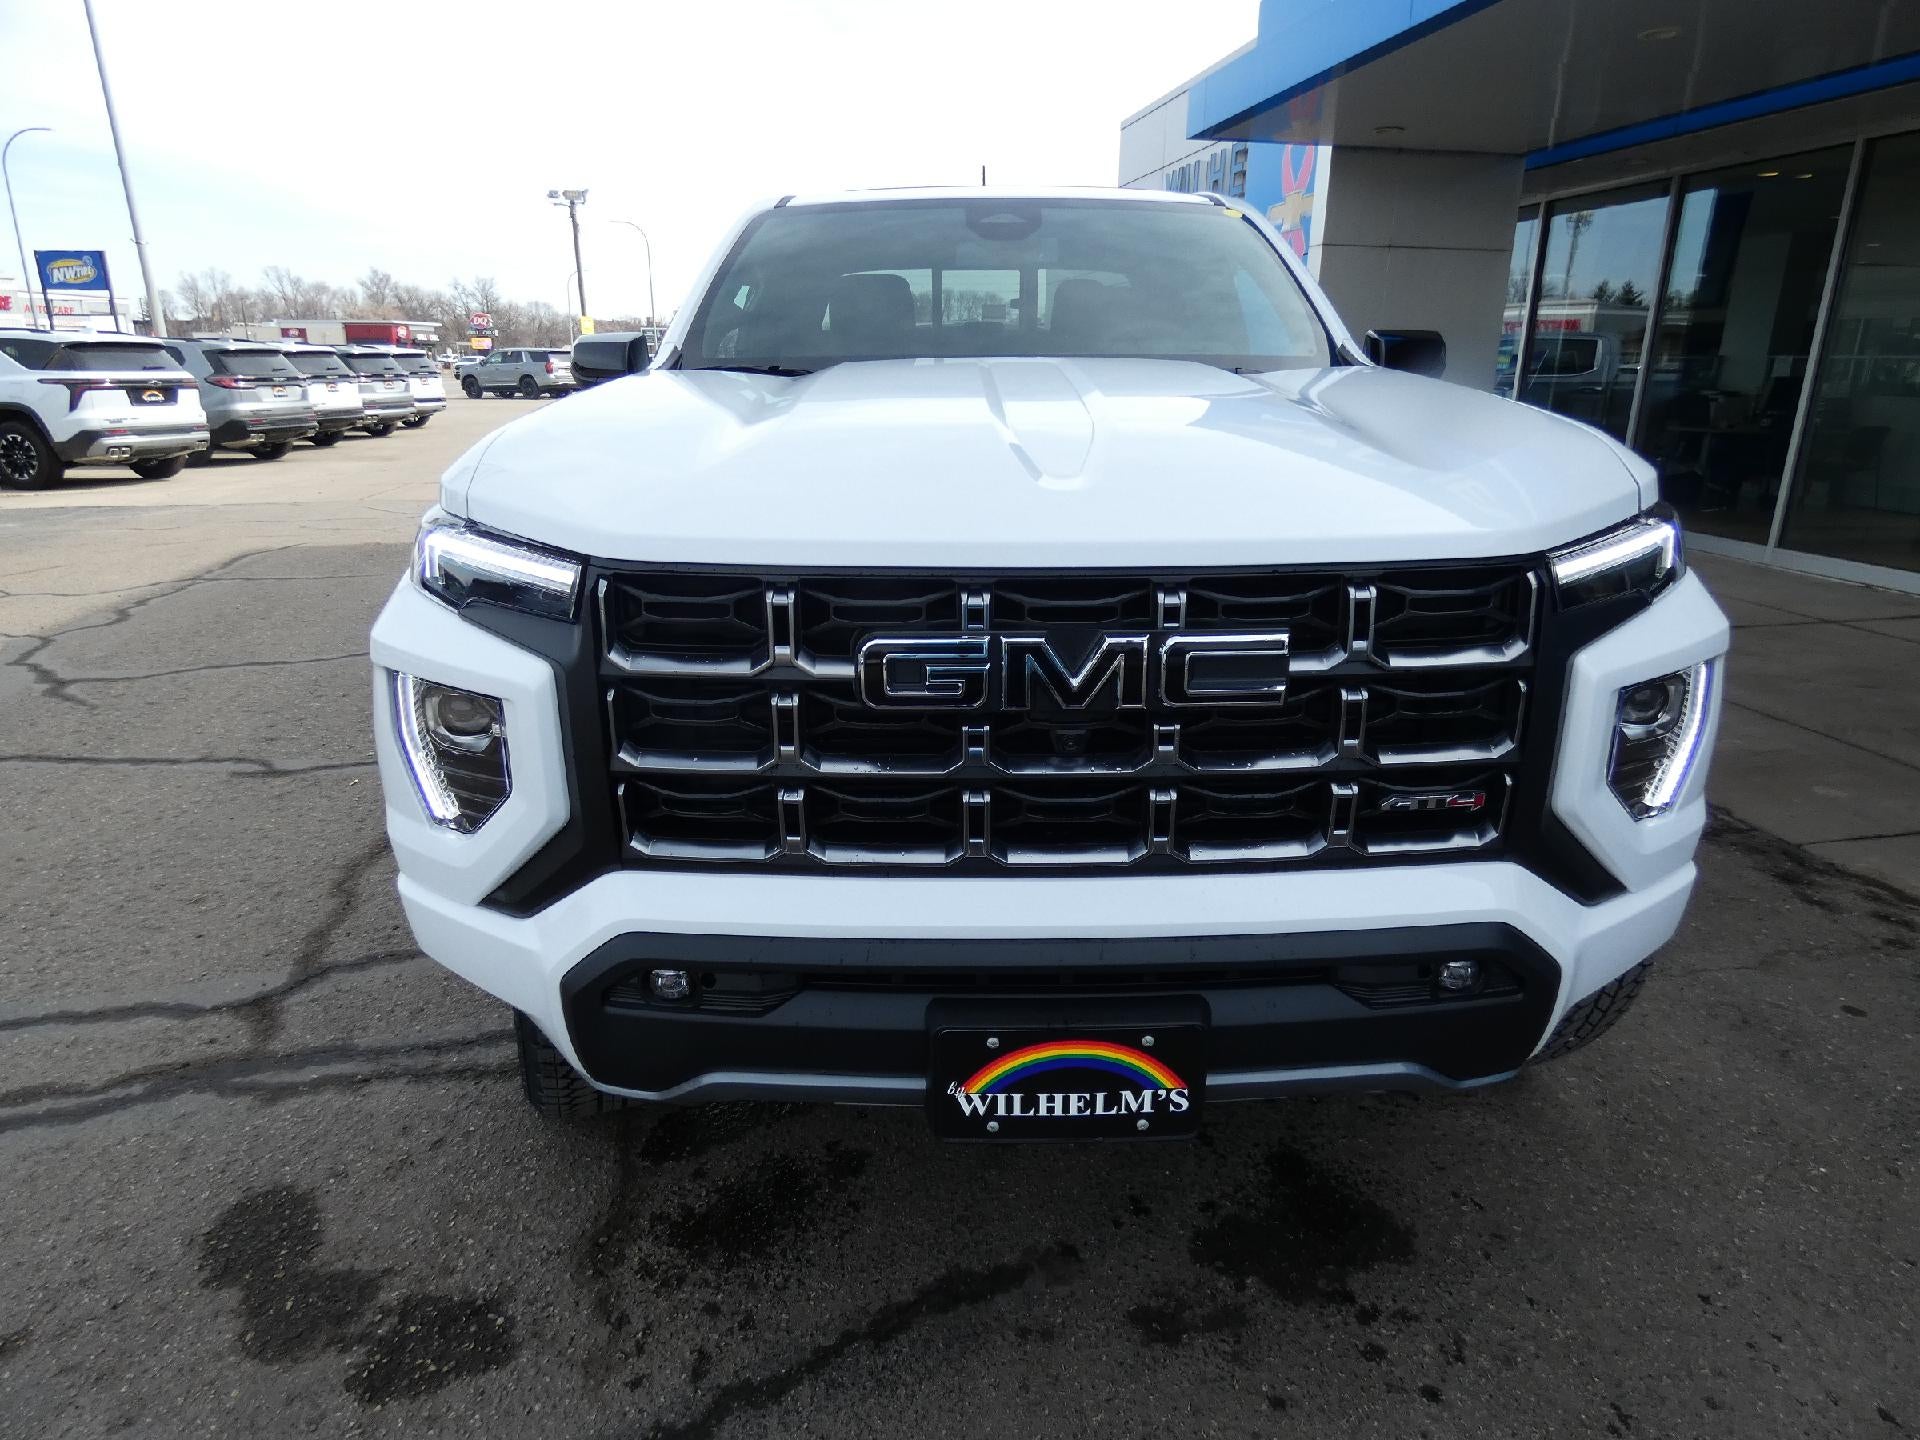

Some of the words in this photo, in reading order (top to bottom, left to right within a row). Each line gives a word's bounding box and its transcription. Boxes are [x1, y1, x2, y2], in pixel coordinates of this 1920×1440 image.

[24, 303, 48, 314] ATO
[857, 633, 1290, 711] GMC
[1379, 792, 1486, 811] AT4
[957, 1088, 1190, 1117] WILHELM'S
